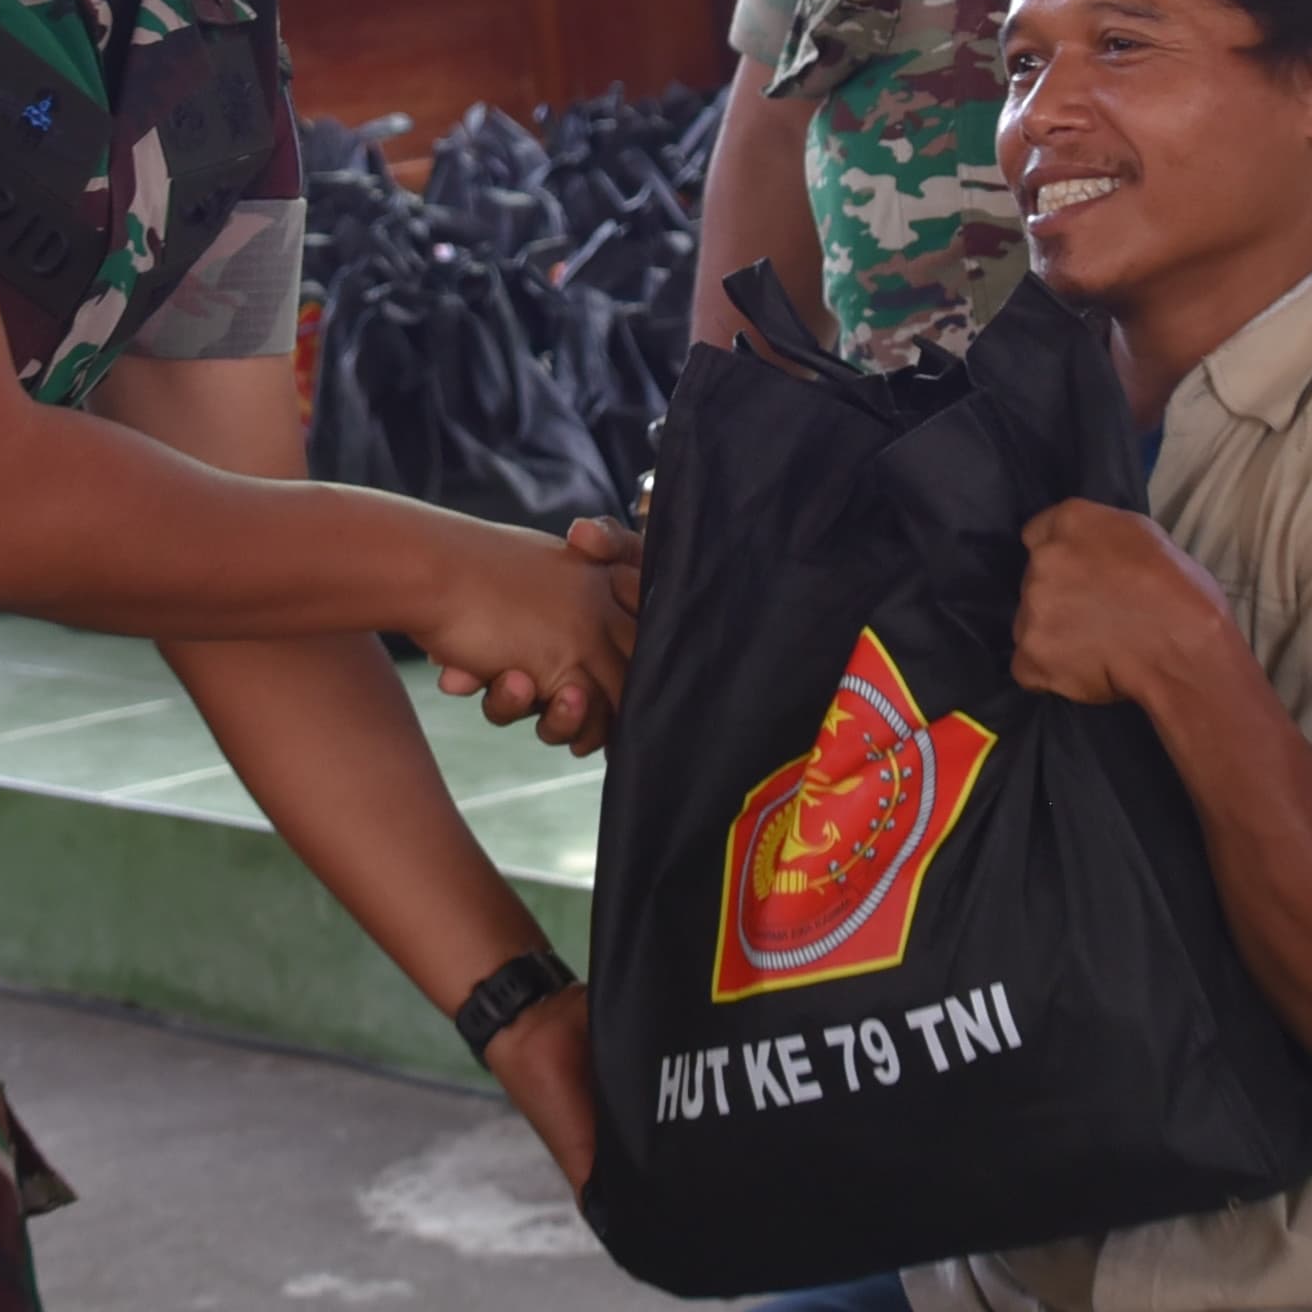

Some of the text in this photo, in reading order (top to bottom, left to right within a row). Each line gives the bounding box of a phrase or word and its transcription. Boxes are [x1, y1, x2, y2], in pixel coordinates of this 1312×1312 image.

[656, 982, 1022, 1123] HUT KE 79 TNI
